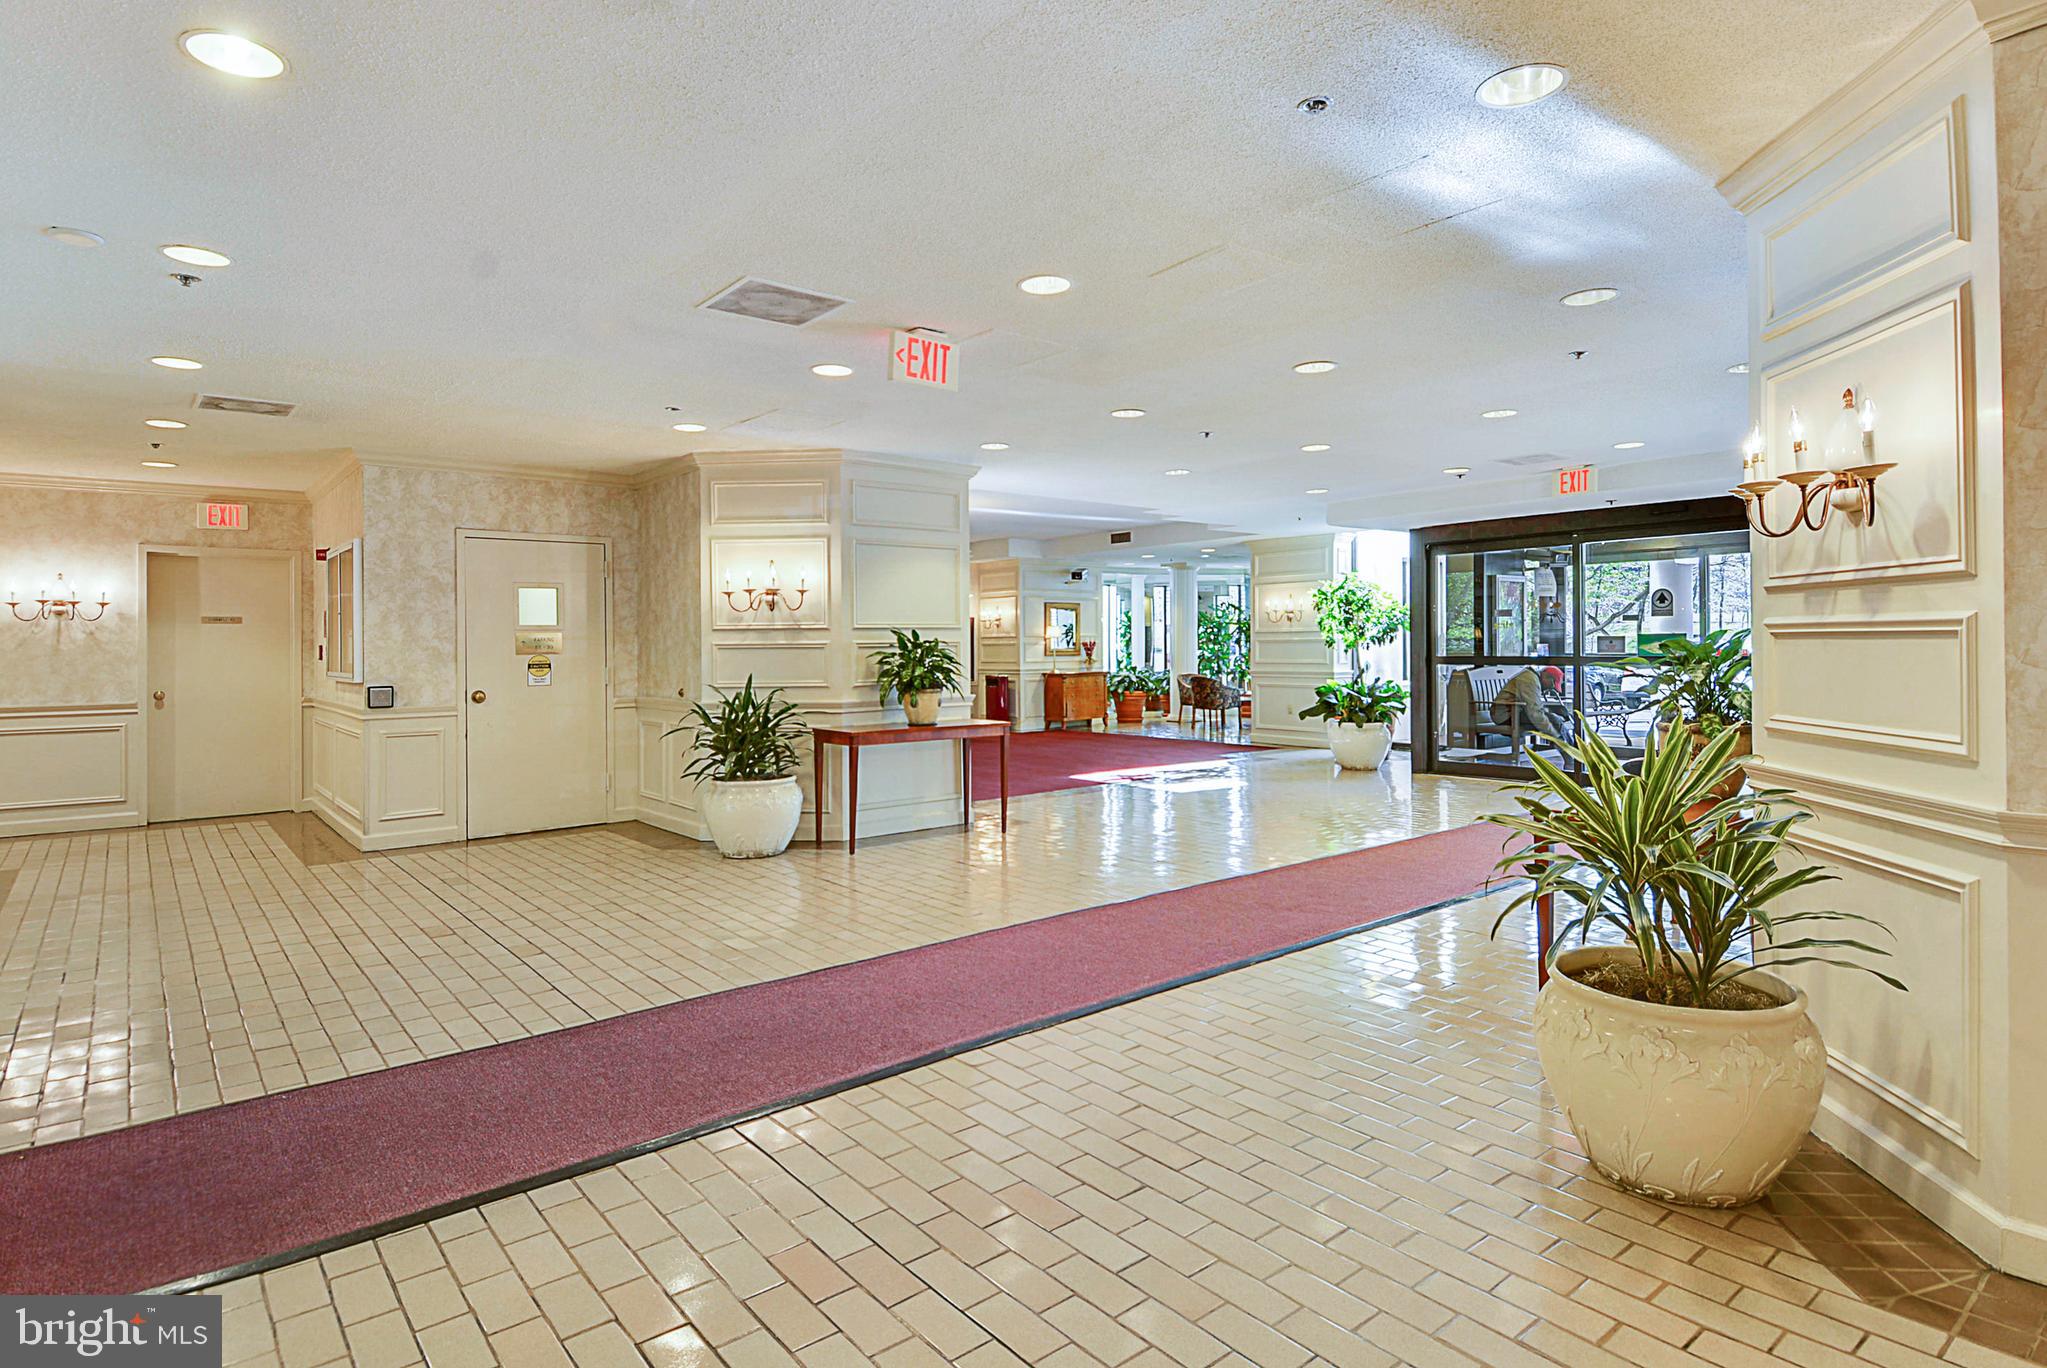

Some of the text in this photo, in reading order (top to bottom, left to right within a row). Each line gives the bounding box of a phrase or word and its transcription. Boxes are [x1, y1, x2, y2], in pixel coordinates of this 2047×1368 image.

[906, 336, 951, 385] EXIT
[1560, 469, 1590, 495] EXIT
[208, 504, 241, 527] EXIT
